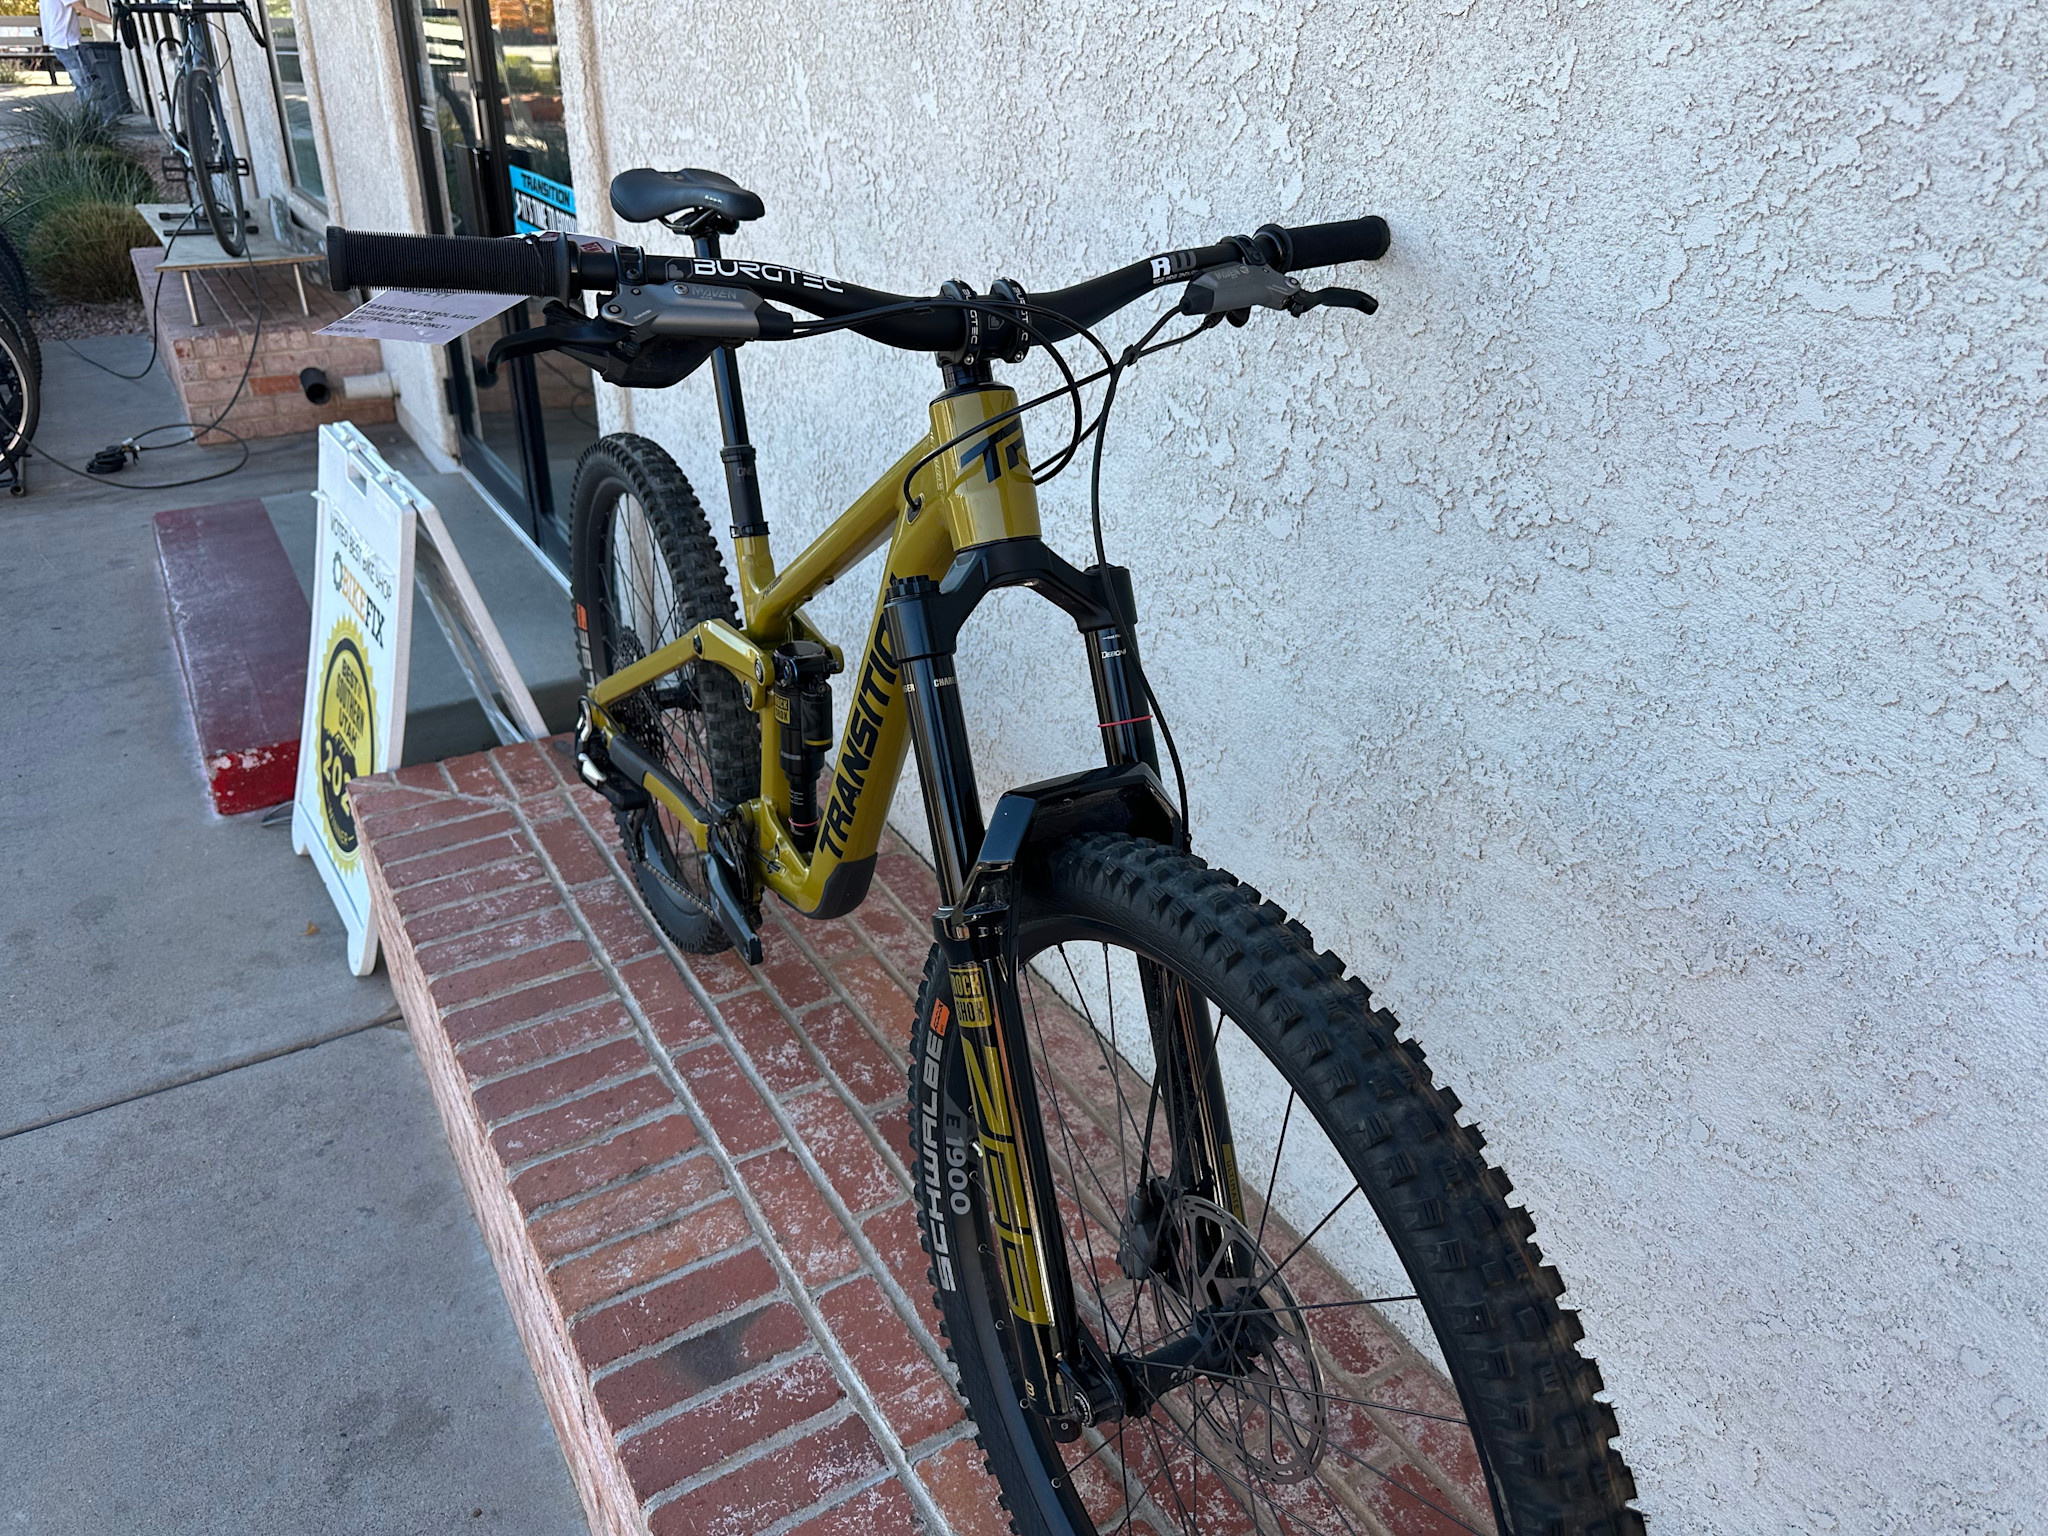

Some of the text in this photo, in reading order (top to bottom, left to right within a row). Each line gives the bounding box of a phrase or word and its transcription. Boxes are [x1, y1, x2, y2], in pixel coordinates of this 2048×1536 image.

[521, 173, 571, 207] TRANSITION
[692, 285, 737, 300] MAVEN
[694, 258, 843, 294] BURGTEC
[330, 512, 348, 548] VOTED
[375, 571, 392, 603] SHOP
[341, 563, 385, 650] BIKEFIX
[336, 672, 365, 738] SOUTHERN
[341, 657, 359, 694] BEST
[338, 705, 358, 751] UTAH
[819, 570, 899, 859] TRANSITIO
[322, 739, 351, 818] 202
[921, 1029, 957, 1293] SCHWALBE
[945, 1136, 972, 1216] 1900
[1226, 1159, 1240, 1211] ULTIMATE
